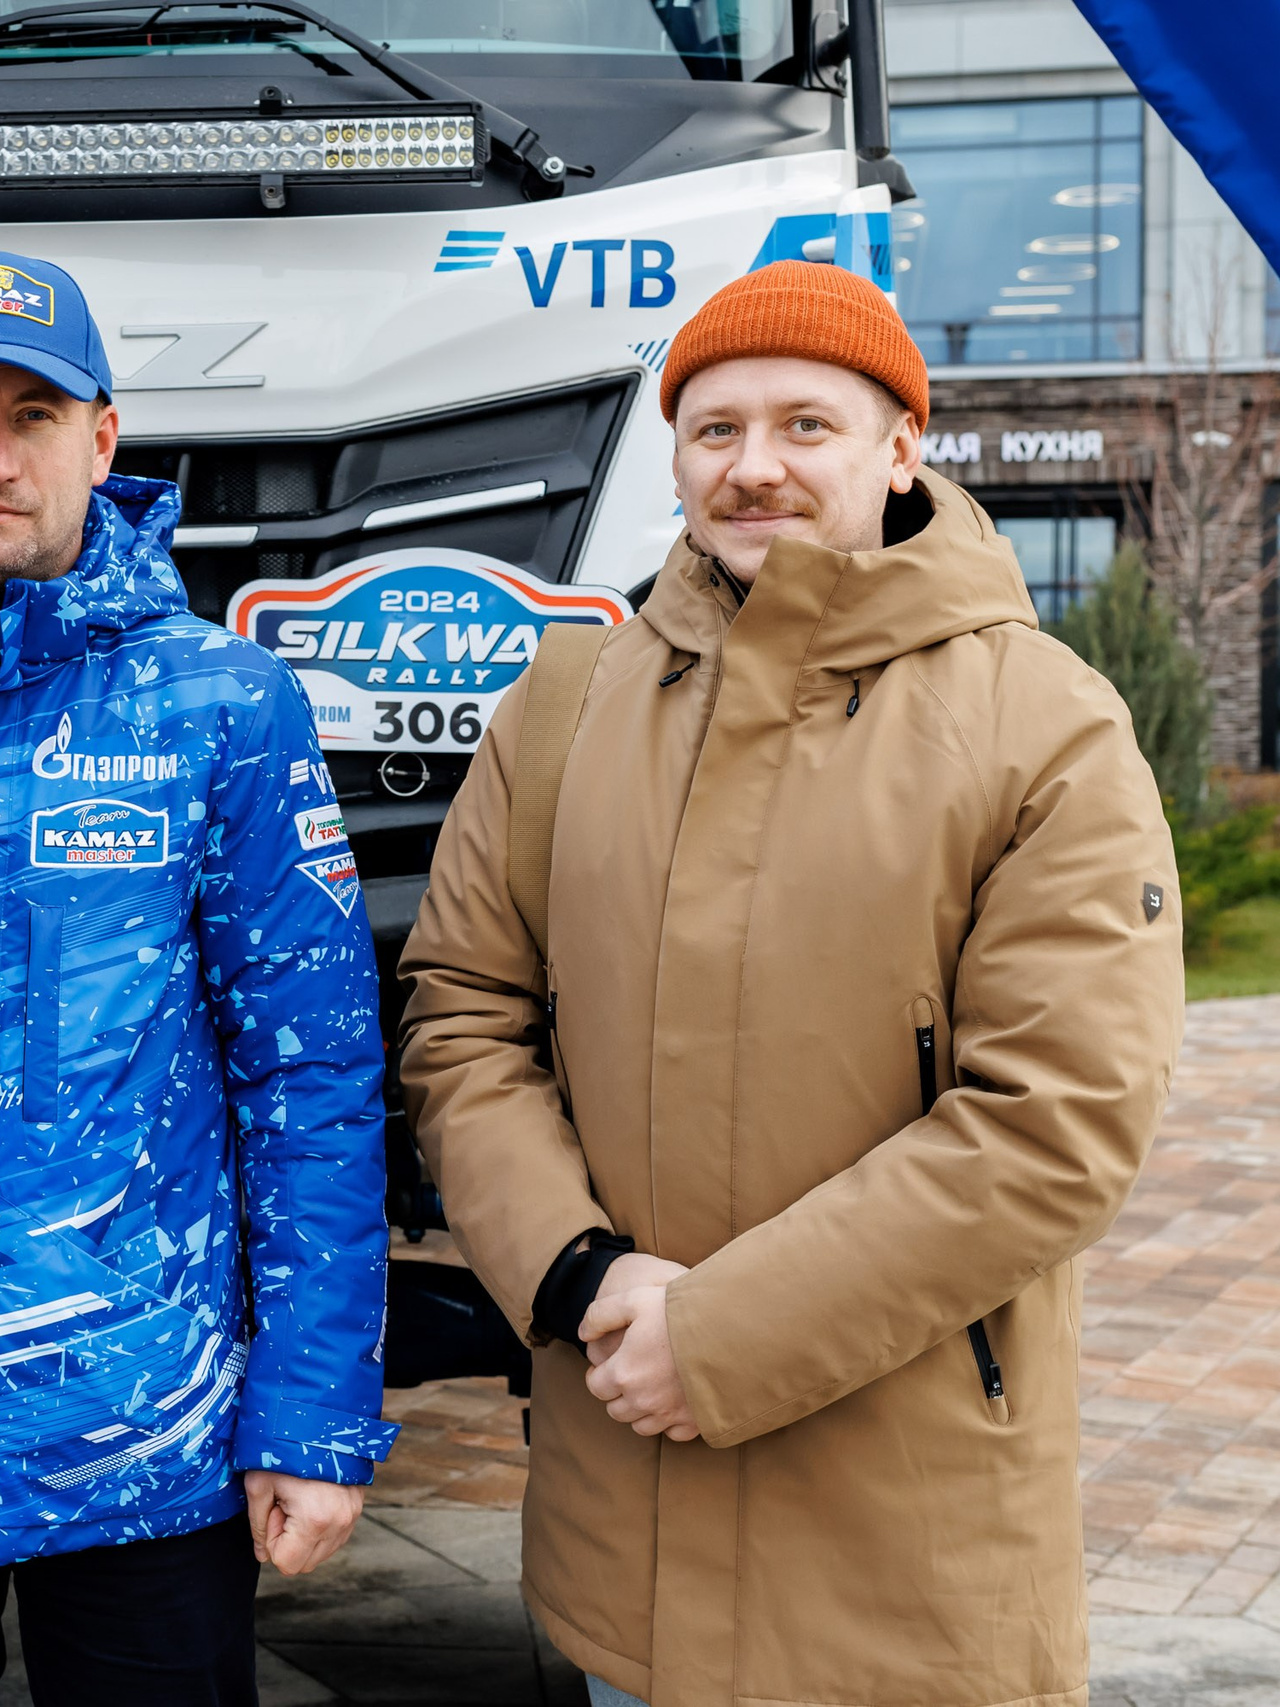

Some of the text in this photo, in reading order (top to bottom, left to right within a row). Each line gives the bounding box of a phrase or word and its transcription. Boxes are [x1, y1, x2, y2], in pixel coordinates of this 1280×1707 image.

[513, 239, 677, 308] VTB
[1001, 430, 1104, 463] КУХНЯ
[380, 590, 481, 613] 2024
[274, 620, 548, 664] SILK WA
[367, 668, 493, 685] RALLY
[373, 701, 483, 745] 306
[72, 753, 178, 782] ГАЗПРОМ
[73, 804, 131, 829] Team
[43, 829, 158, 848] KAMAZ
[66, 848, 136, 863] master
